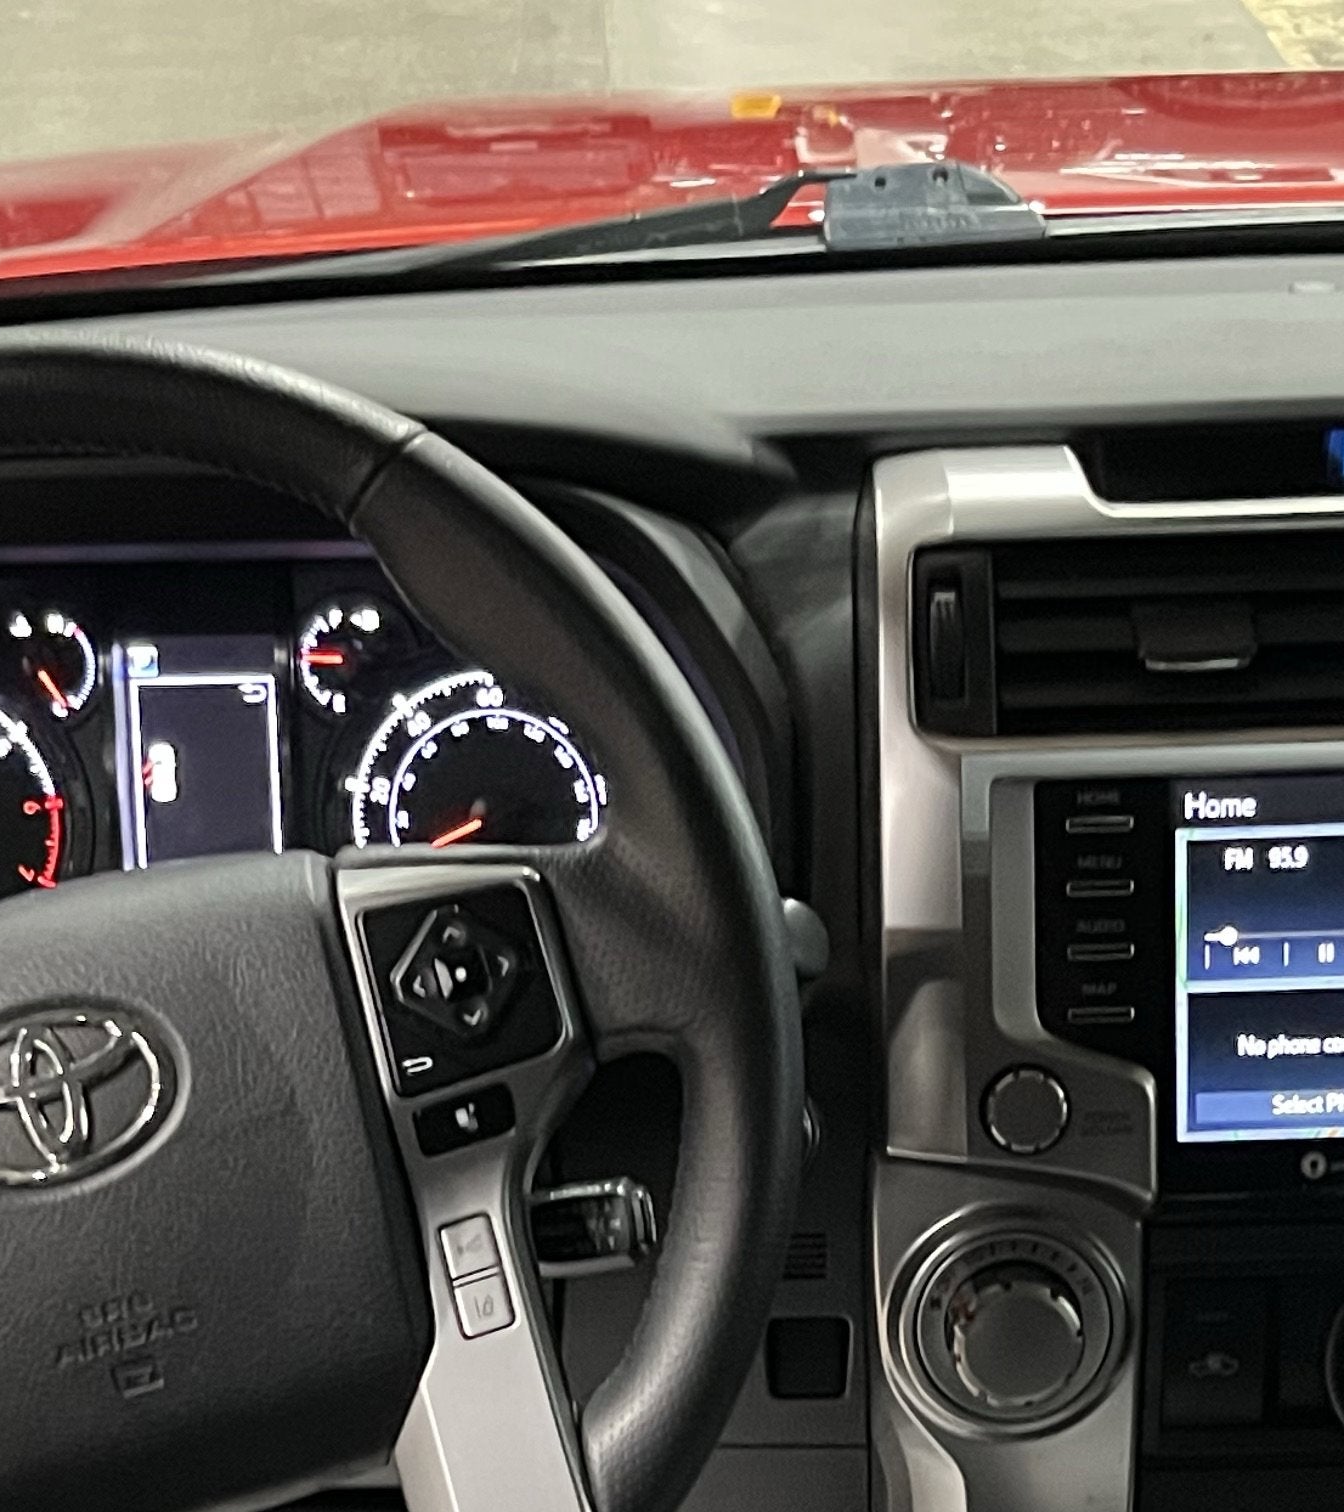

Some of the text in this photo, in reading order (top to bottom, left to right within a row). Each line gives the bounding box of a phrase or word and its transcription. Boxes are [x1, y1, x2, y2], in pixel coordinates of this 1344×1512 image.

[1184, 791, 1257, 819] Home
[1224, 846, 1254, 870] FM
[1237, 1034, 1266, 1056] No
[1267, 1034, 1321, 1059] phone
[1271, 1094, 1324, 1115] Select
